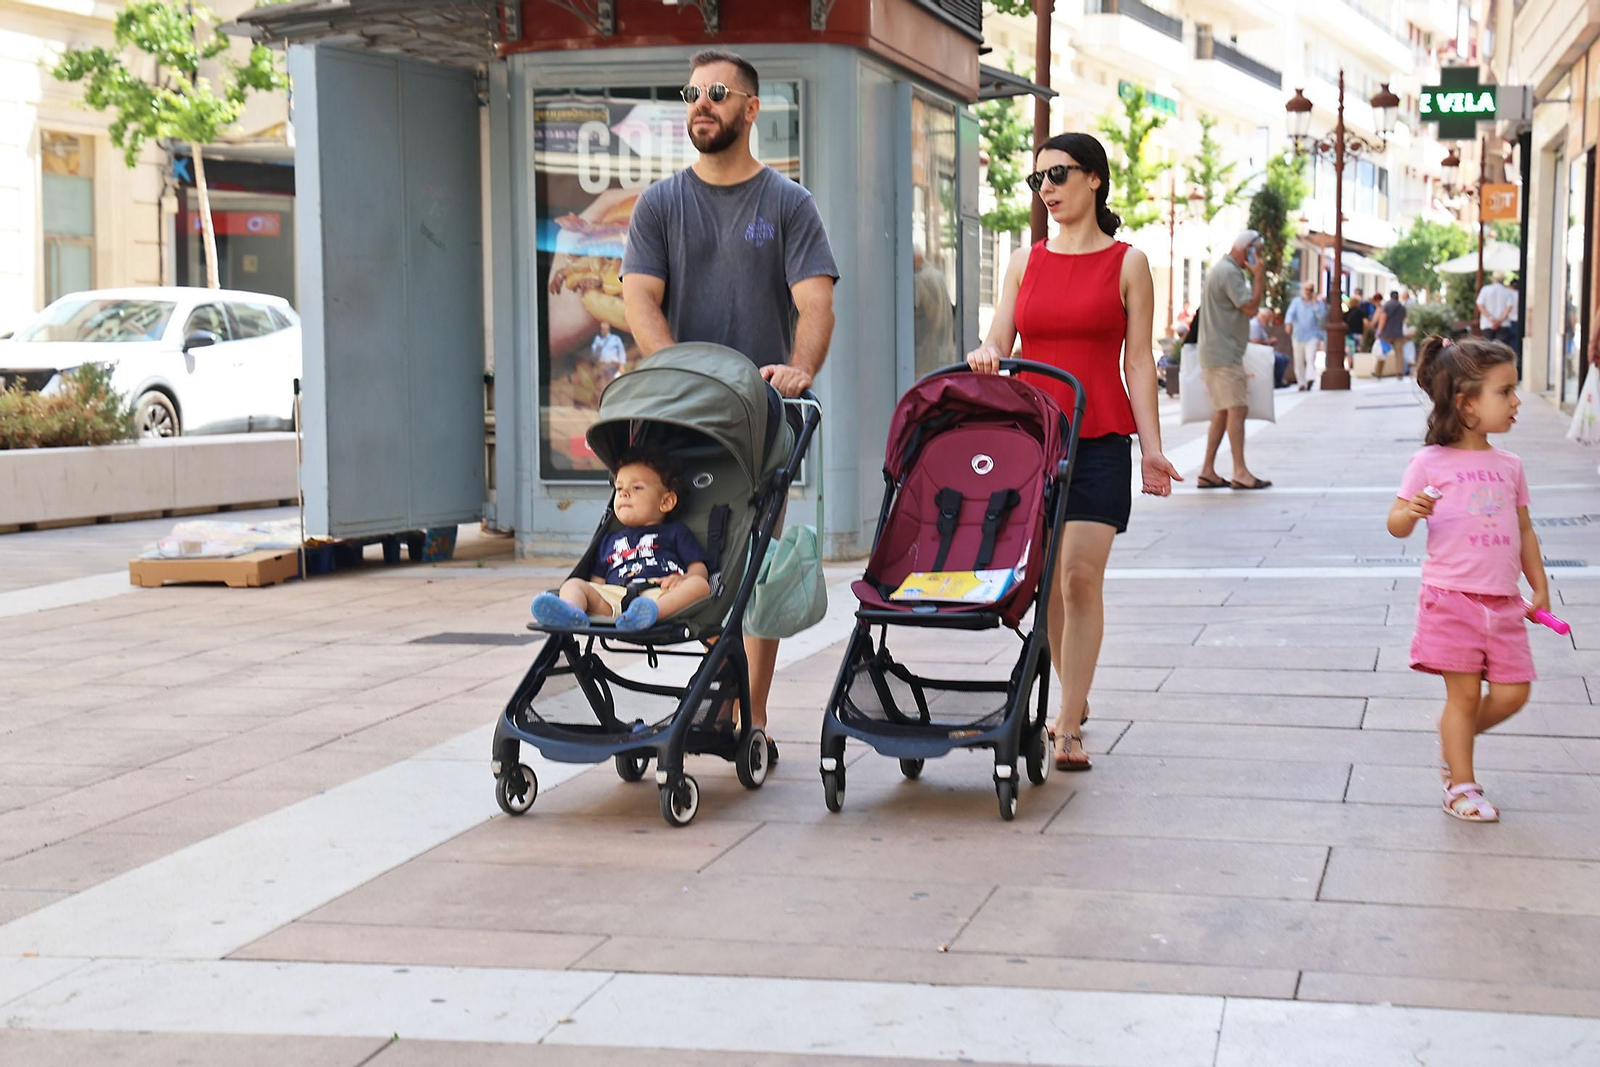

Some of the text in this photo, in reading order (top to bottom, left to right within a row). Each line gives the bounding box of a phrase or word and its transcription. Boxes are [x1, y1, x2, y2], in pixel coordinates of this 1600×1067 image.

[1436, 92, 1496, 113] VILA
[1456, 469, 1505, 483] SHELL
[1469, 534, 1511, 547] YEAH
